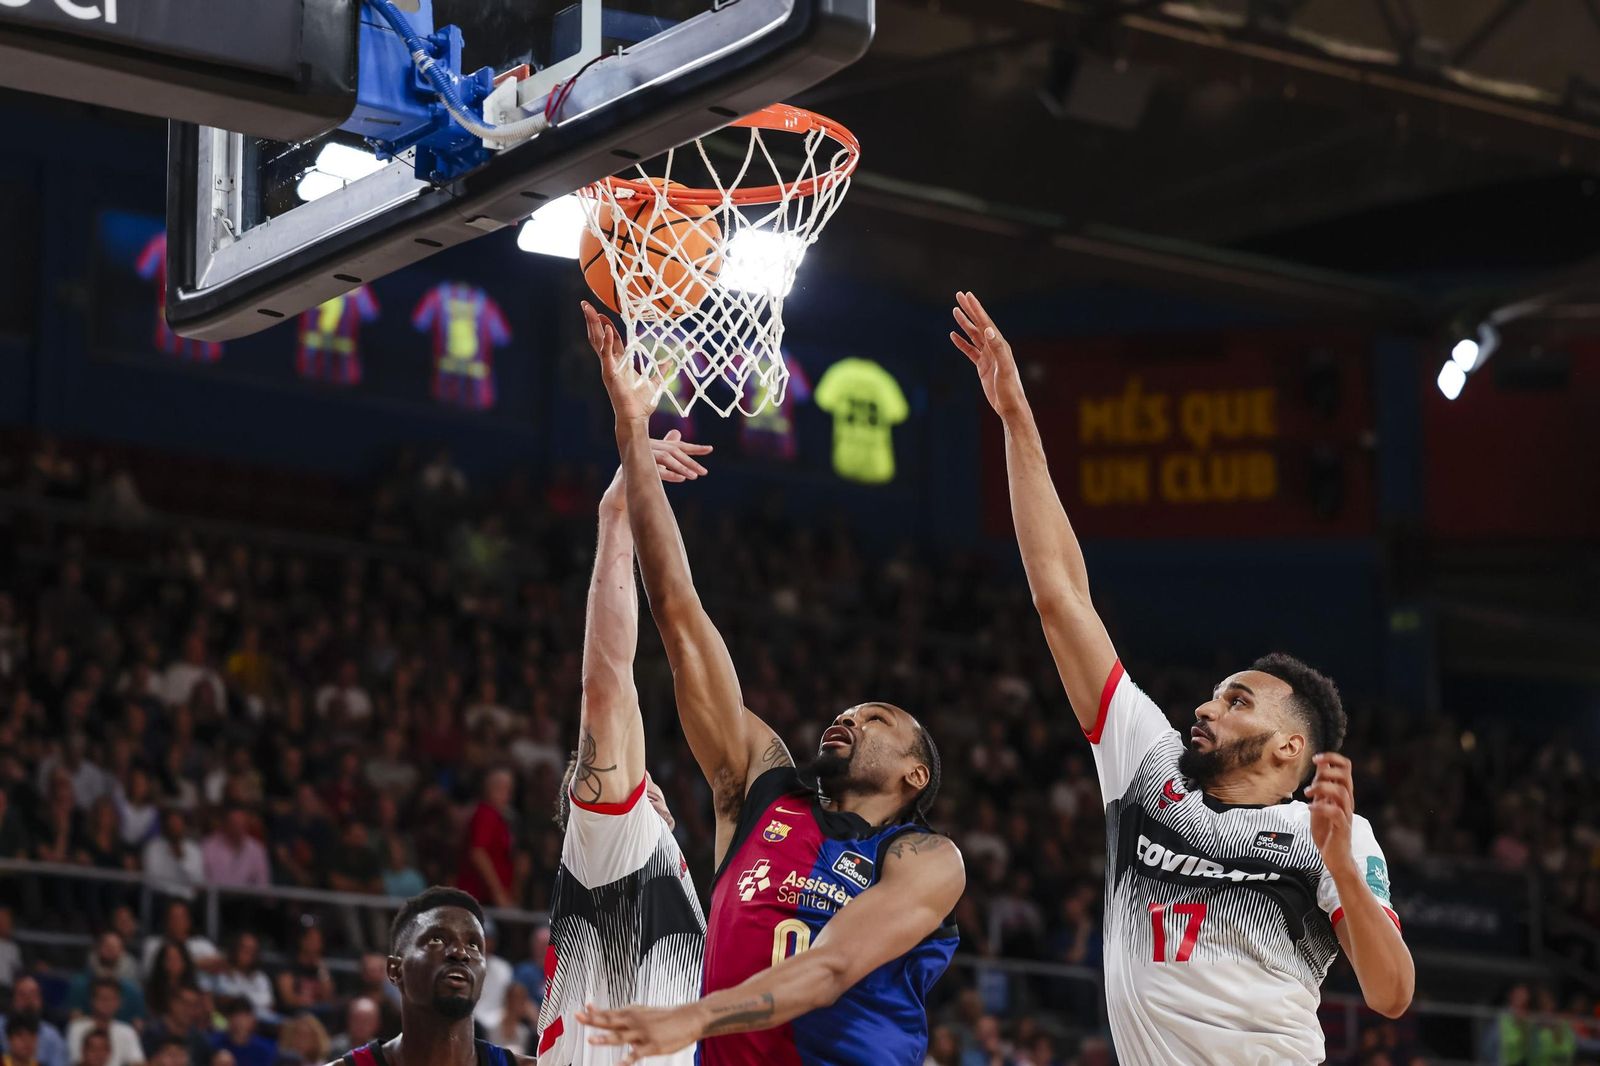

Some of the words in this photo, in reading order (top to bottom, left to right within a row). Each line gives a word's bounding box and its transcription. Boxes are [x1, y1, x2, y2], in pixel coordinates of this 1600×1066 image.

[1080, 374, 1168, 444] MÉS
[1181, 387, 1277, 450] QUE
[1080, 458, 1149, 505] UN
[1162, 452, 1277, 502] CLUB
[1256, 841, 1289, 851] endesa
[1259, 834, 1273, 842] liga
[837, 864, 868, 885] endesa
[841, 857, 856, 869] liga
[772, 918, 811, 967] 0
[1148, 903, 1207, 962] 17
